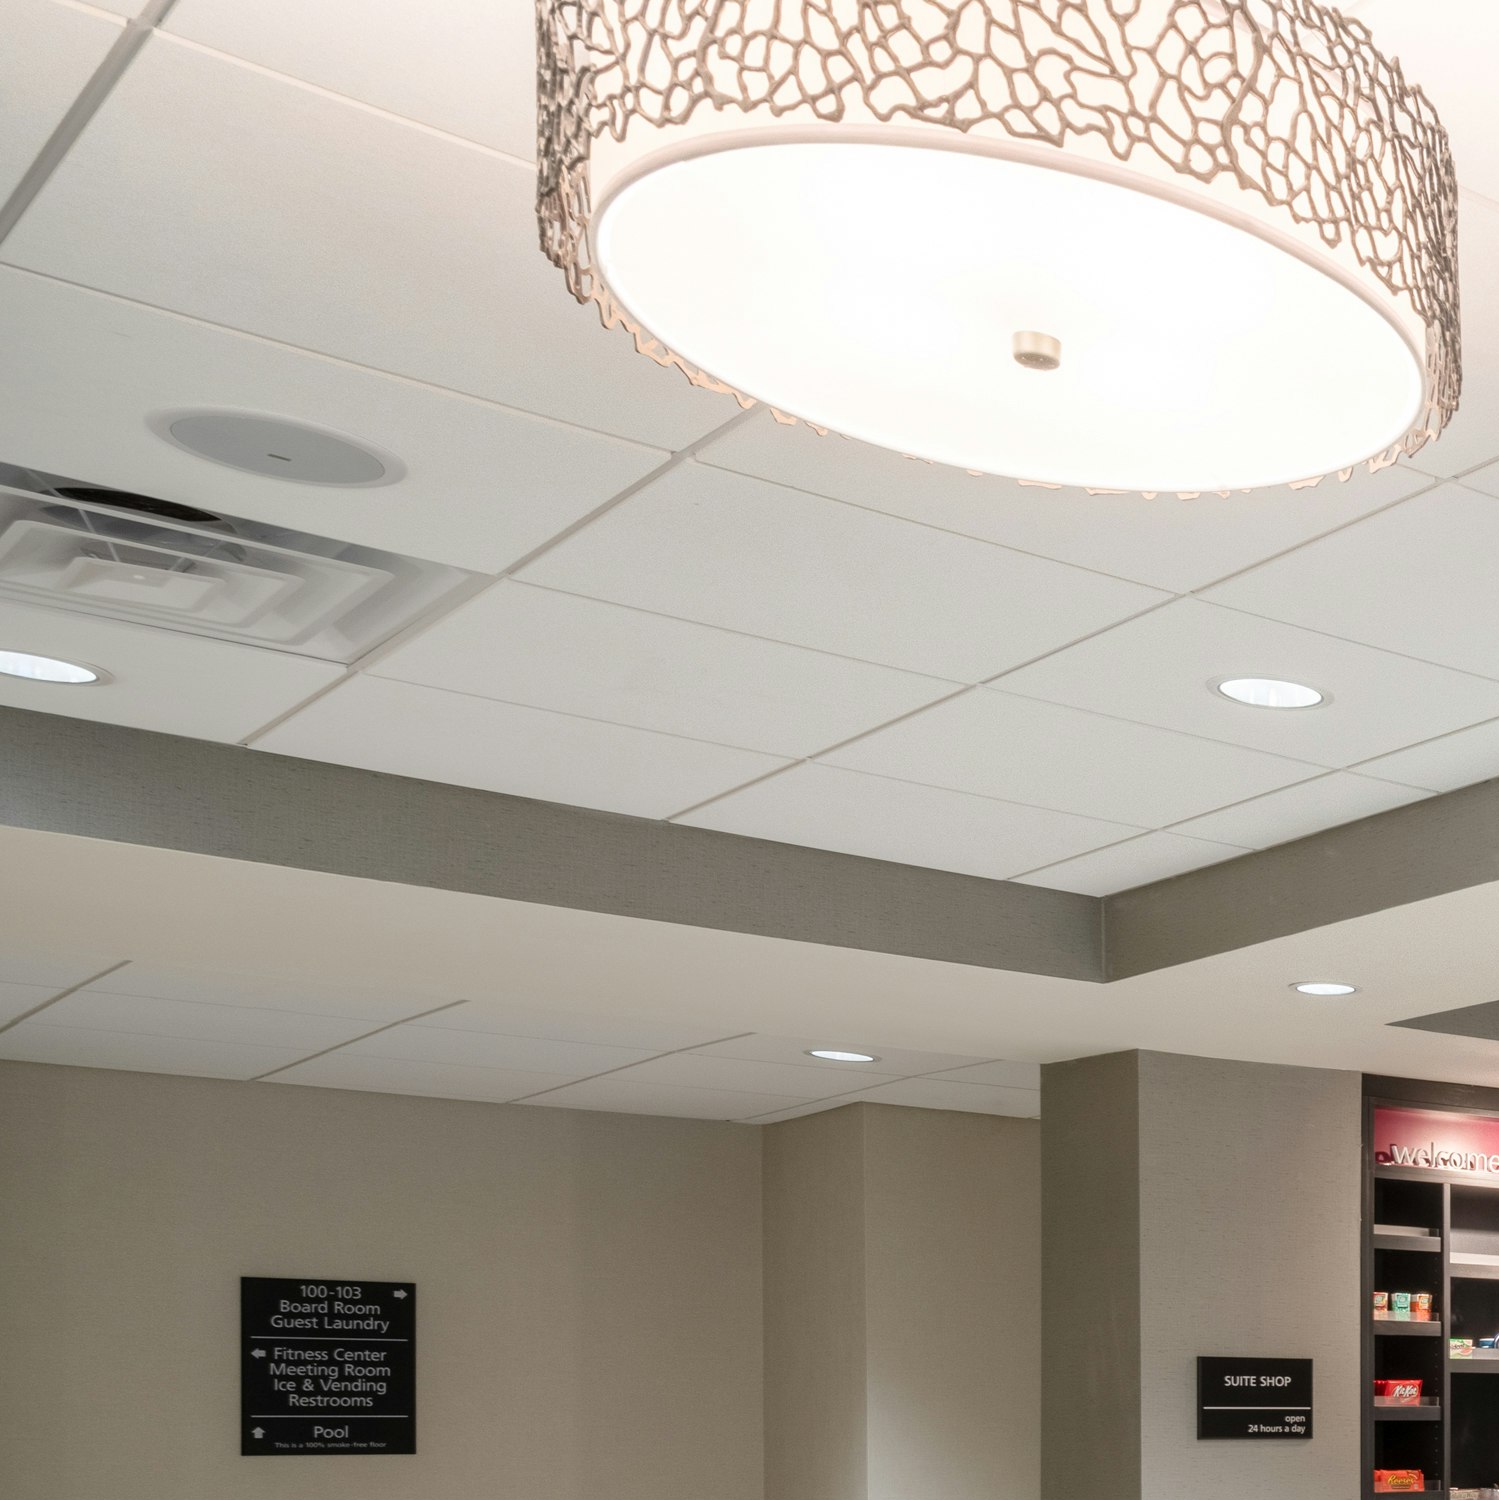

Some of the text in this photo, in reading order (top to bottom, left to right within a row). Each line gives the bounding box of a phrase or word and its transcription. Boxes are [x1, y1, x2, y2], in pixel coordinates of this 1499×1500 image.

[300, 1285, 362, 1299] 100-103
[280, 1300, 381, 1315] Board Room
[270, 1315, 390, 1333] Guest Laundry
[274, 1347, 387, 1362] Fitness Center
[269, 1363, 391, 1379] Meeting Room
[274, 1379, 387, 1395] Ice & Vending
[1224, 1375, 1292, 1387] SUITE SHOP
[289, 1394, 373, 1407] Restrooms
[1284, 1415, 1306, 1424] open
[313, 1425, 349, 1439] Pool
[1247, 1424, 1306, 1434] 24 hours a day
